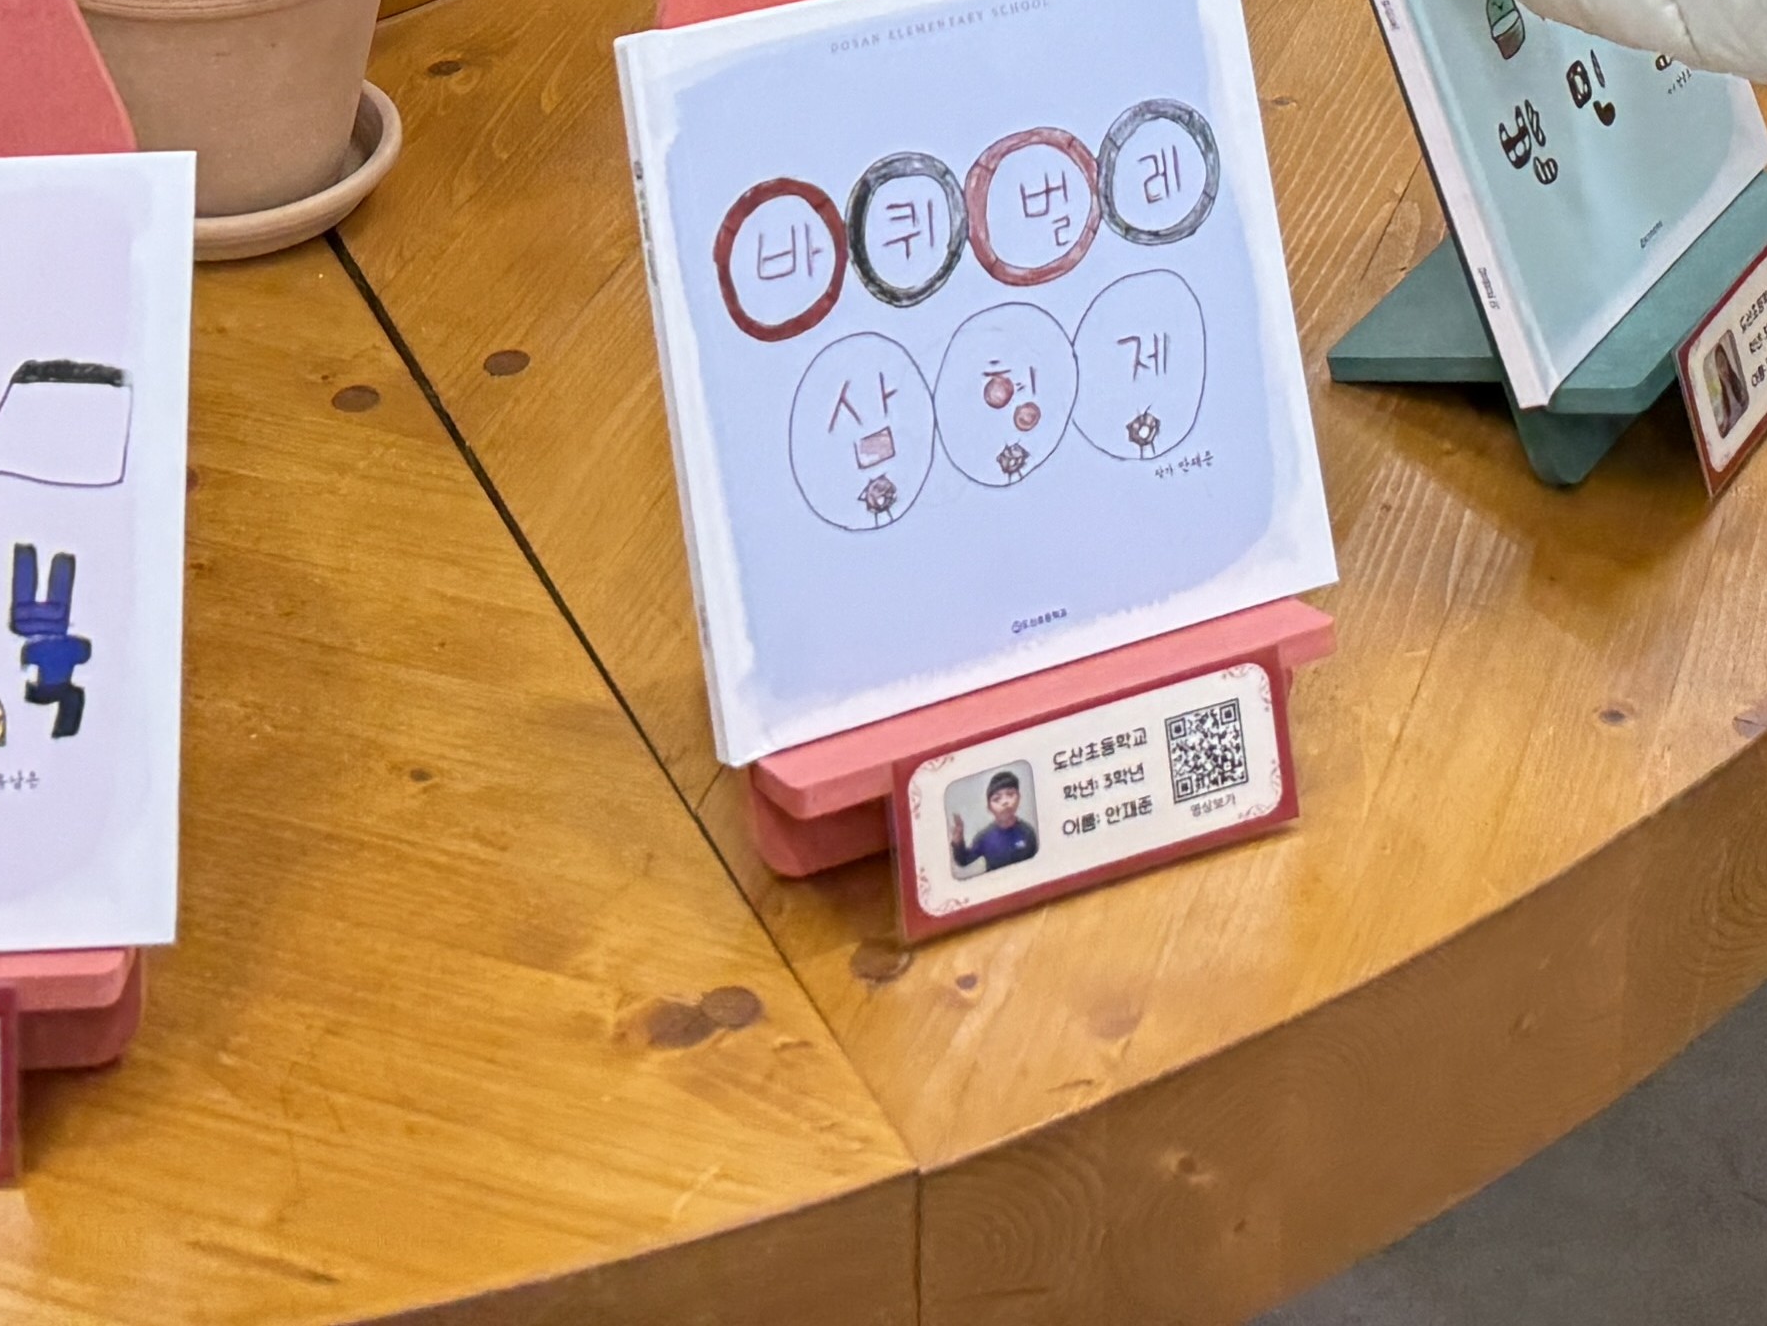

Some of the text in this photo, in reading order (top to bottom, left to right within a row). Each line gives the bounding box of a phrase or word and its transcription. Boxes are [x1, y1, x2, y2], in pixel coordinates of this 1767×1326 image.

[830, 31, 882, 55] DOSAN
[887, 9, 986, 43] ELEMENTARY
[1052, 727, 1149, 771] 도산초등학교
[1063, 761, 1146, 800] 학년: 3학년
[1062, 811, 1101, 836] 이름:
